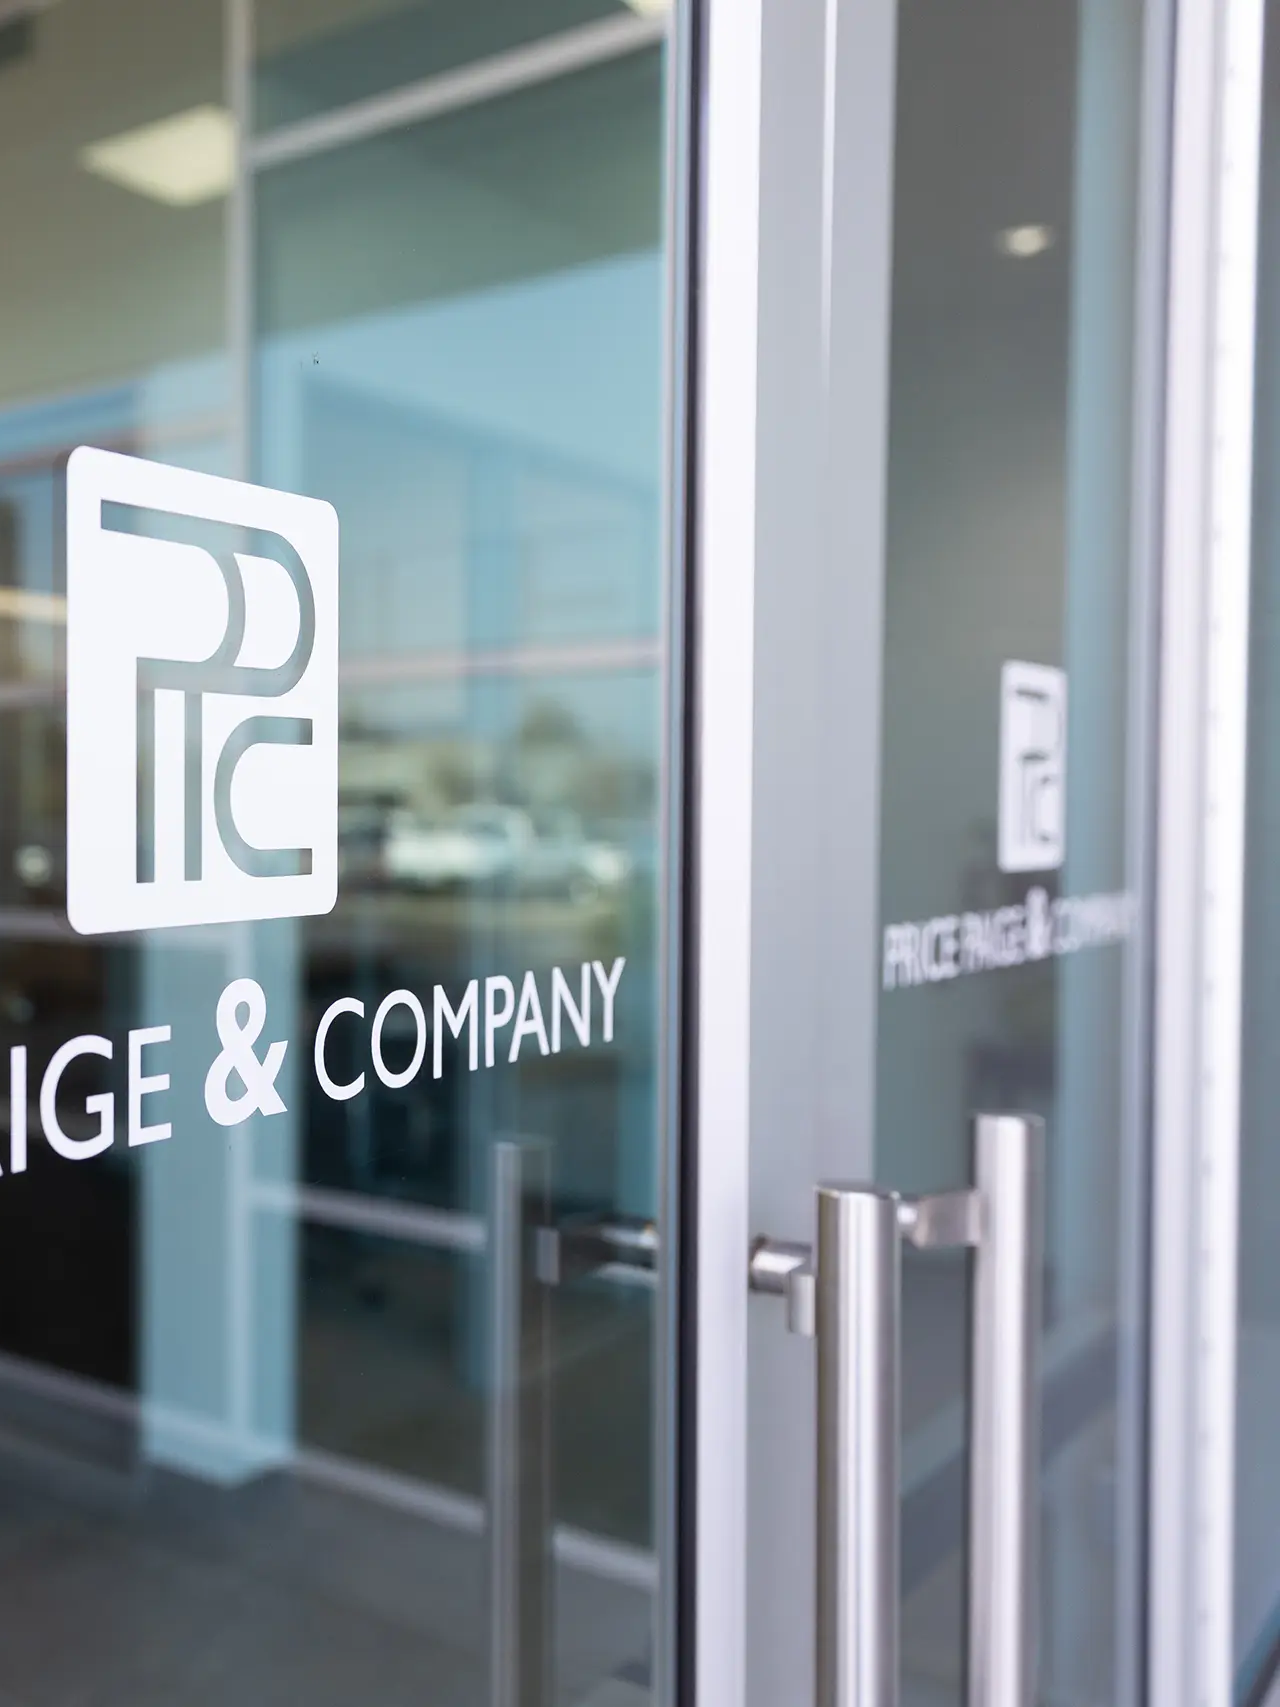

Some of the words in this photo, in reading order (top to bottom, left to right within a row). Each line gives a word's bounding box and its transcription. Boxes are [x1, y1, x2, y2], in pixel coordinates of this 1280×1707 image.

[883, 913, 961, 991] PRICE
[204, 978, 288, 1127] &
[314, 957, 626, 1101] COMPANY
